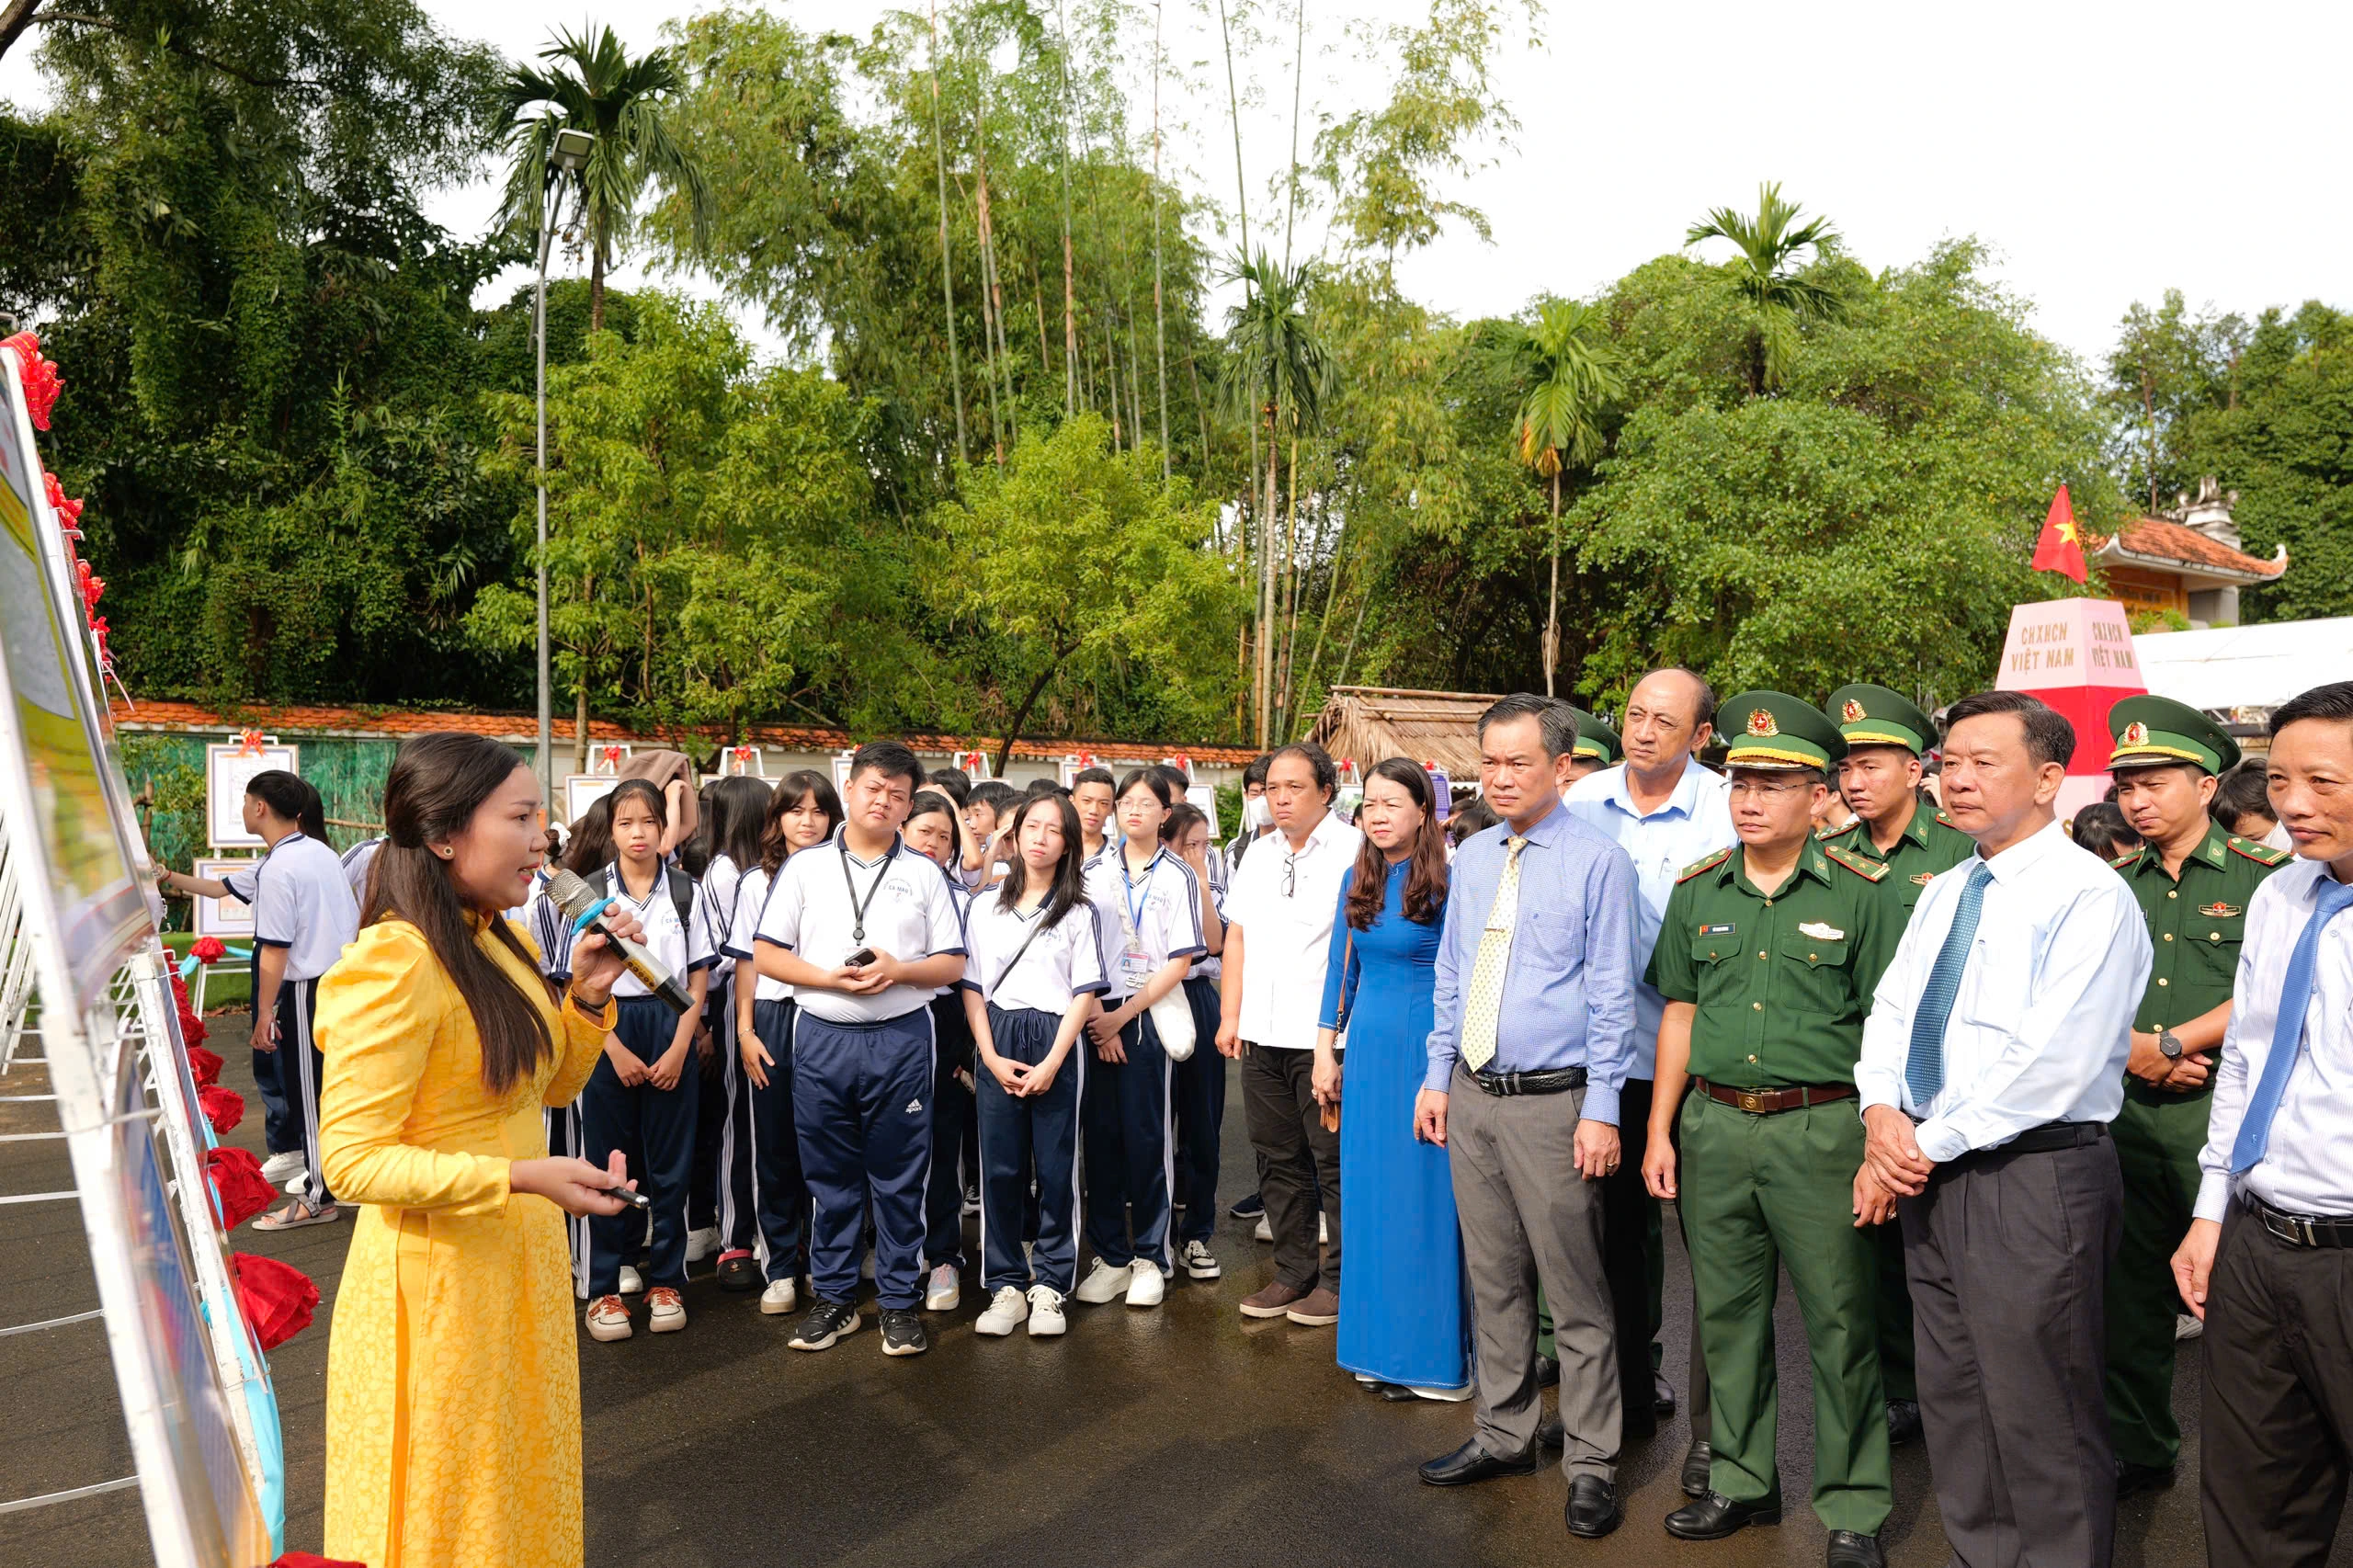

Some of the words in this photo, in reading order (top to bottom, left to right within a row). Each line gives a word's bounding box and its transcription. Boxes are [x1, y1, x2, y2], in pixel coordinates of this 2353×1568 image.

[2021, 622, 2067, 645] CHXHCN
[2092, 621, 2123, 642] CHXHCN
[2011, 647, 2040, 675] VIỆT
[2046, 647, 2075, 668] NAM
[2113, 649, 2133, 669] NAM
